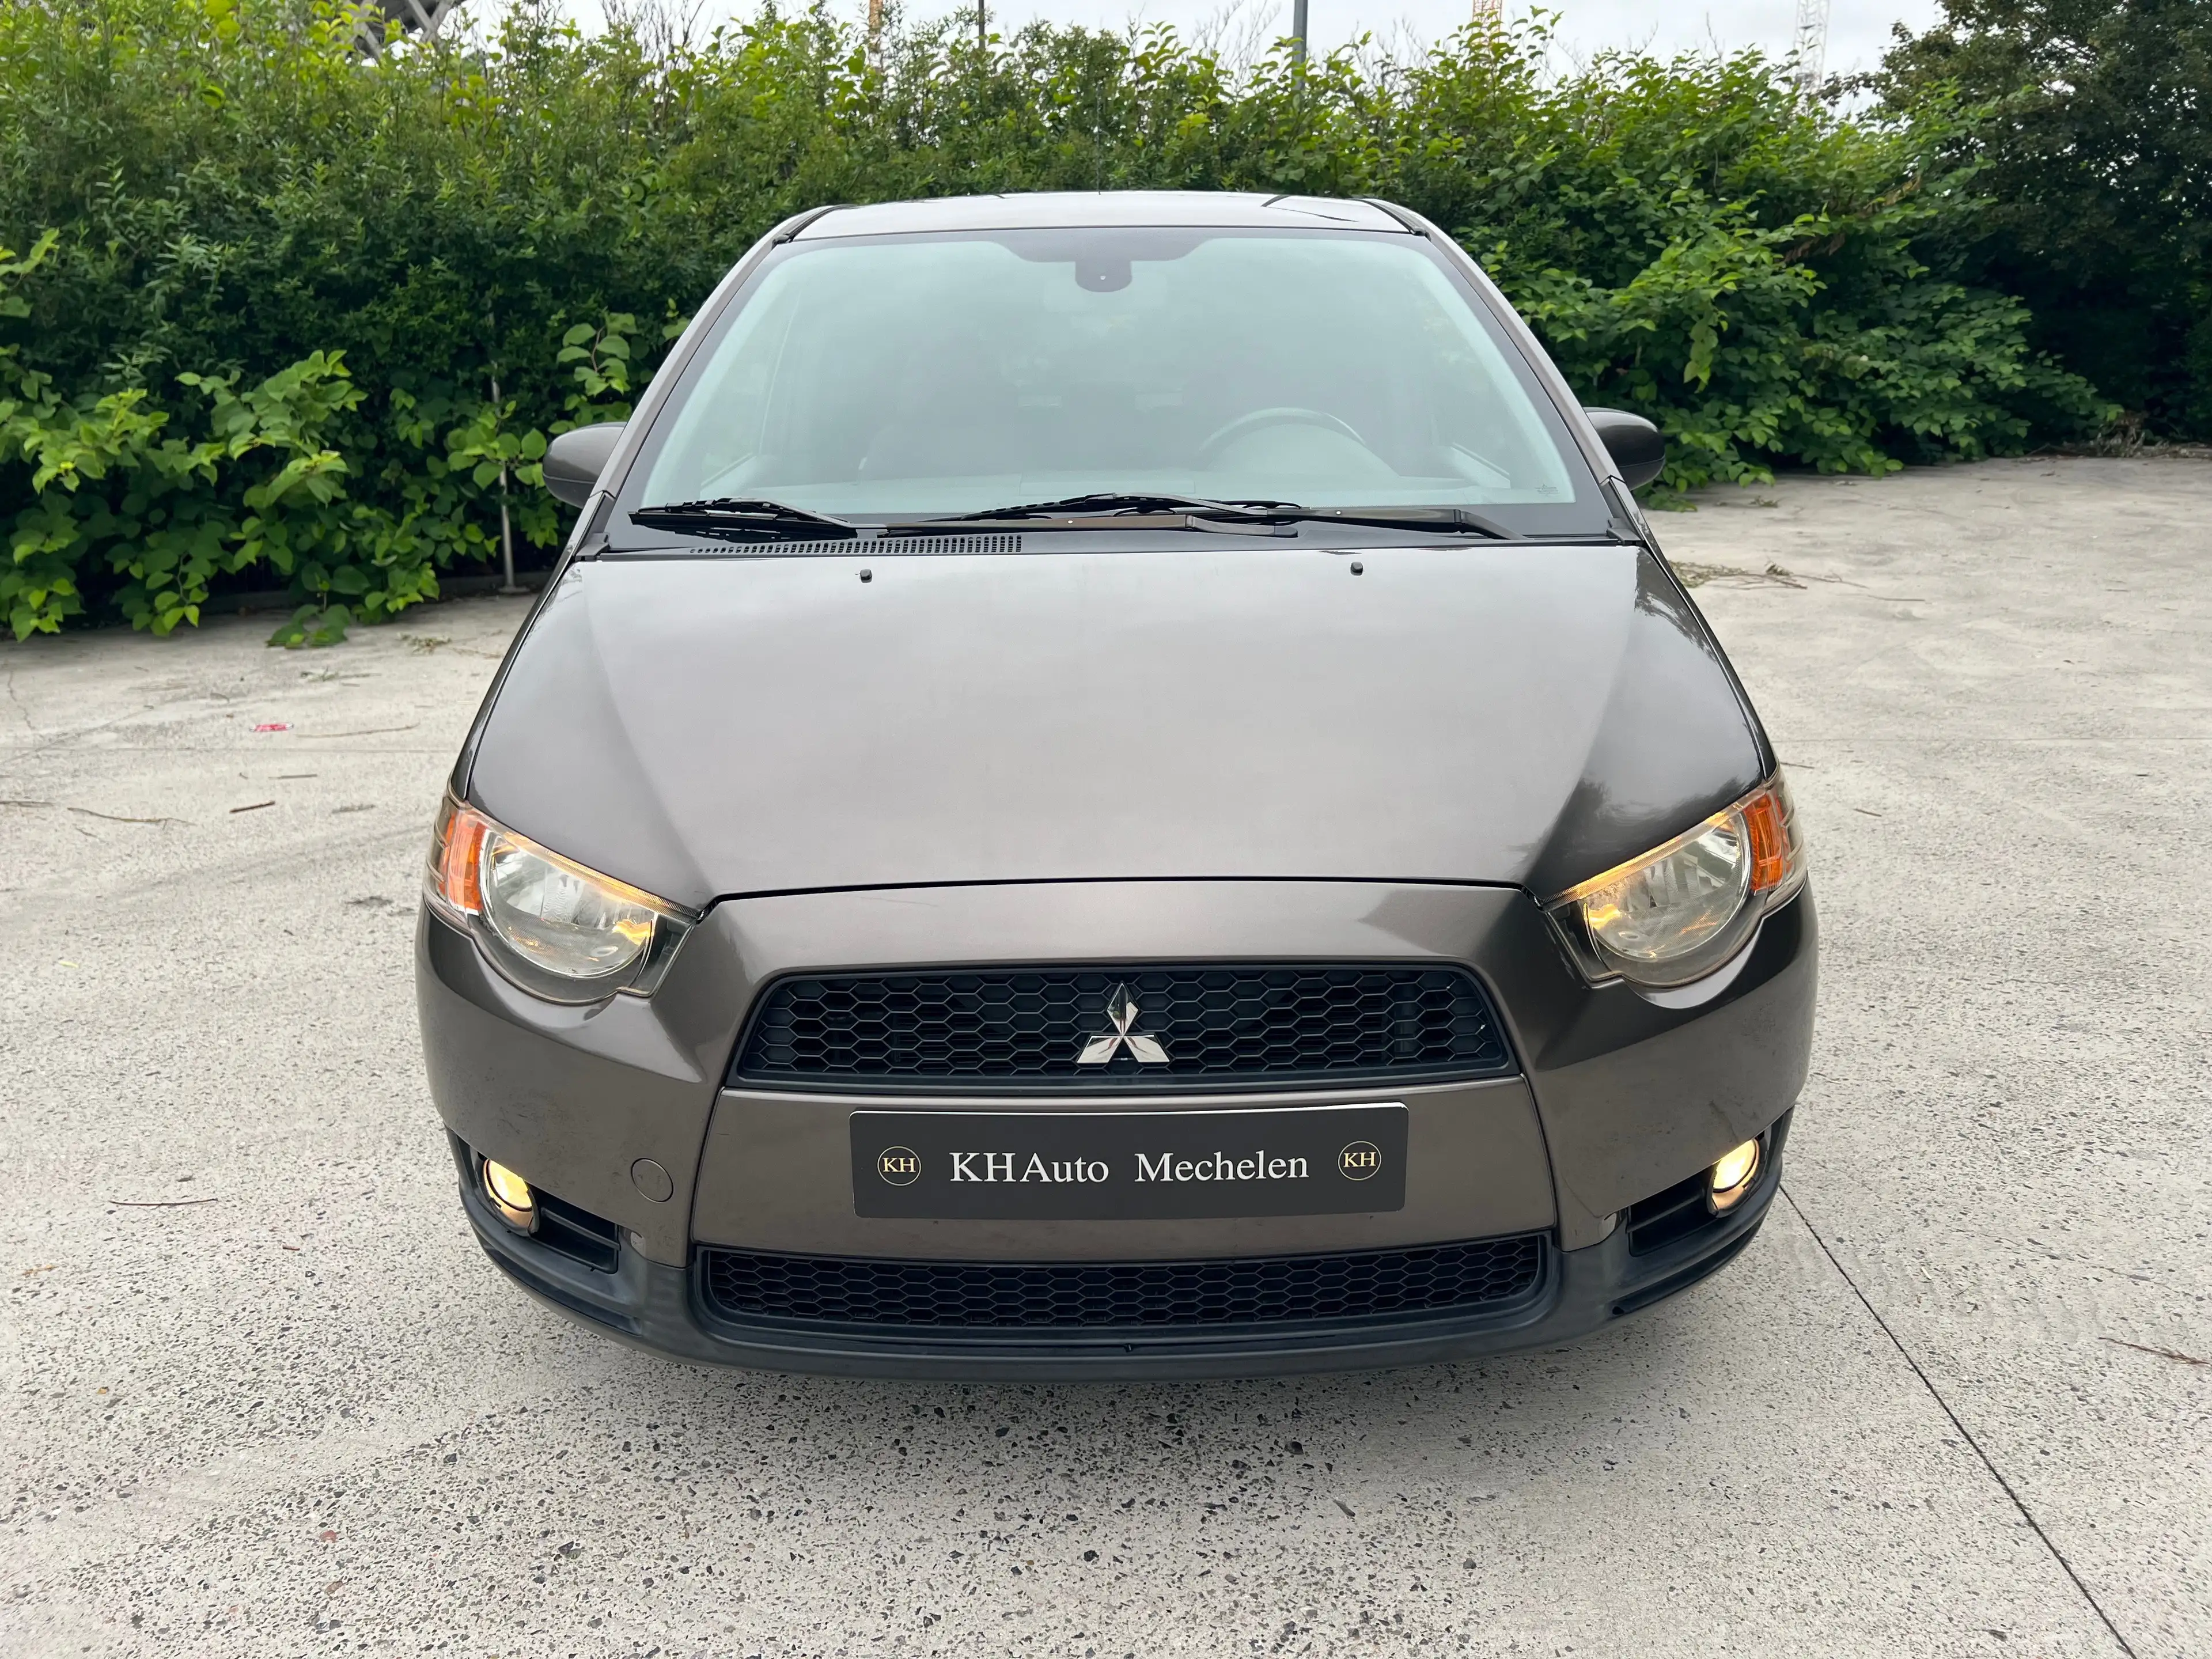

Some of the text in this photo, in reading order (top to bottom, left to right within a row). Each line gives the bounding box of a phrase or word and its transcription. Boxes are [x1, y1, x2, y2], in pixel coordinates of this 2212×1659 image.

[882, 1157, 916, 1172] KH
[949, 1150, 1309, 1182] KHAuto Mechelen
[1343, 1152, 1377, 1168] KH
